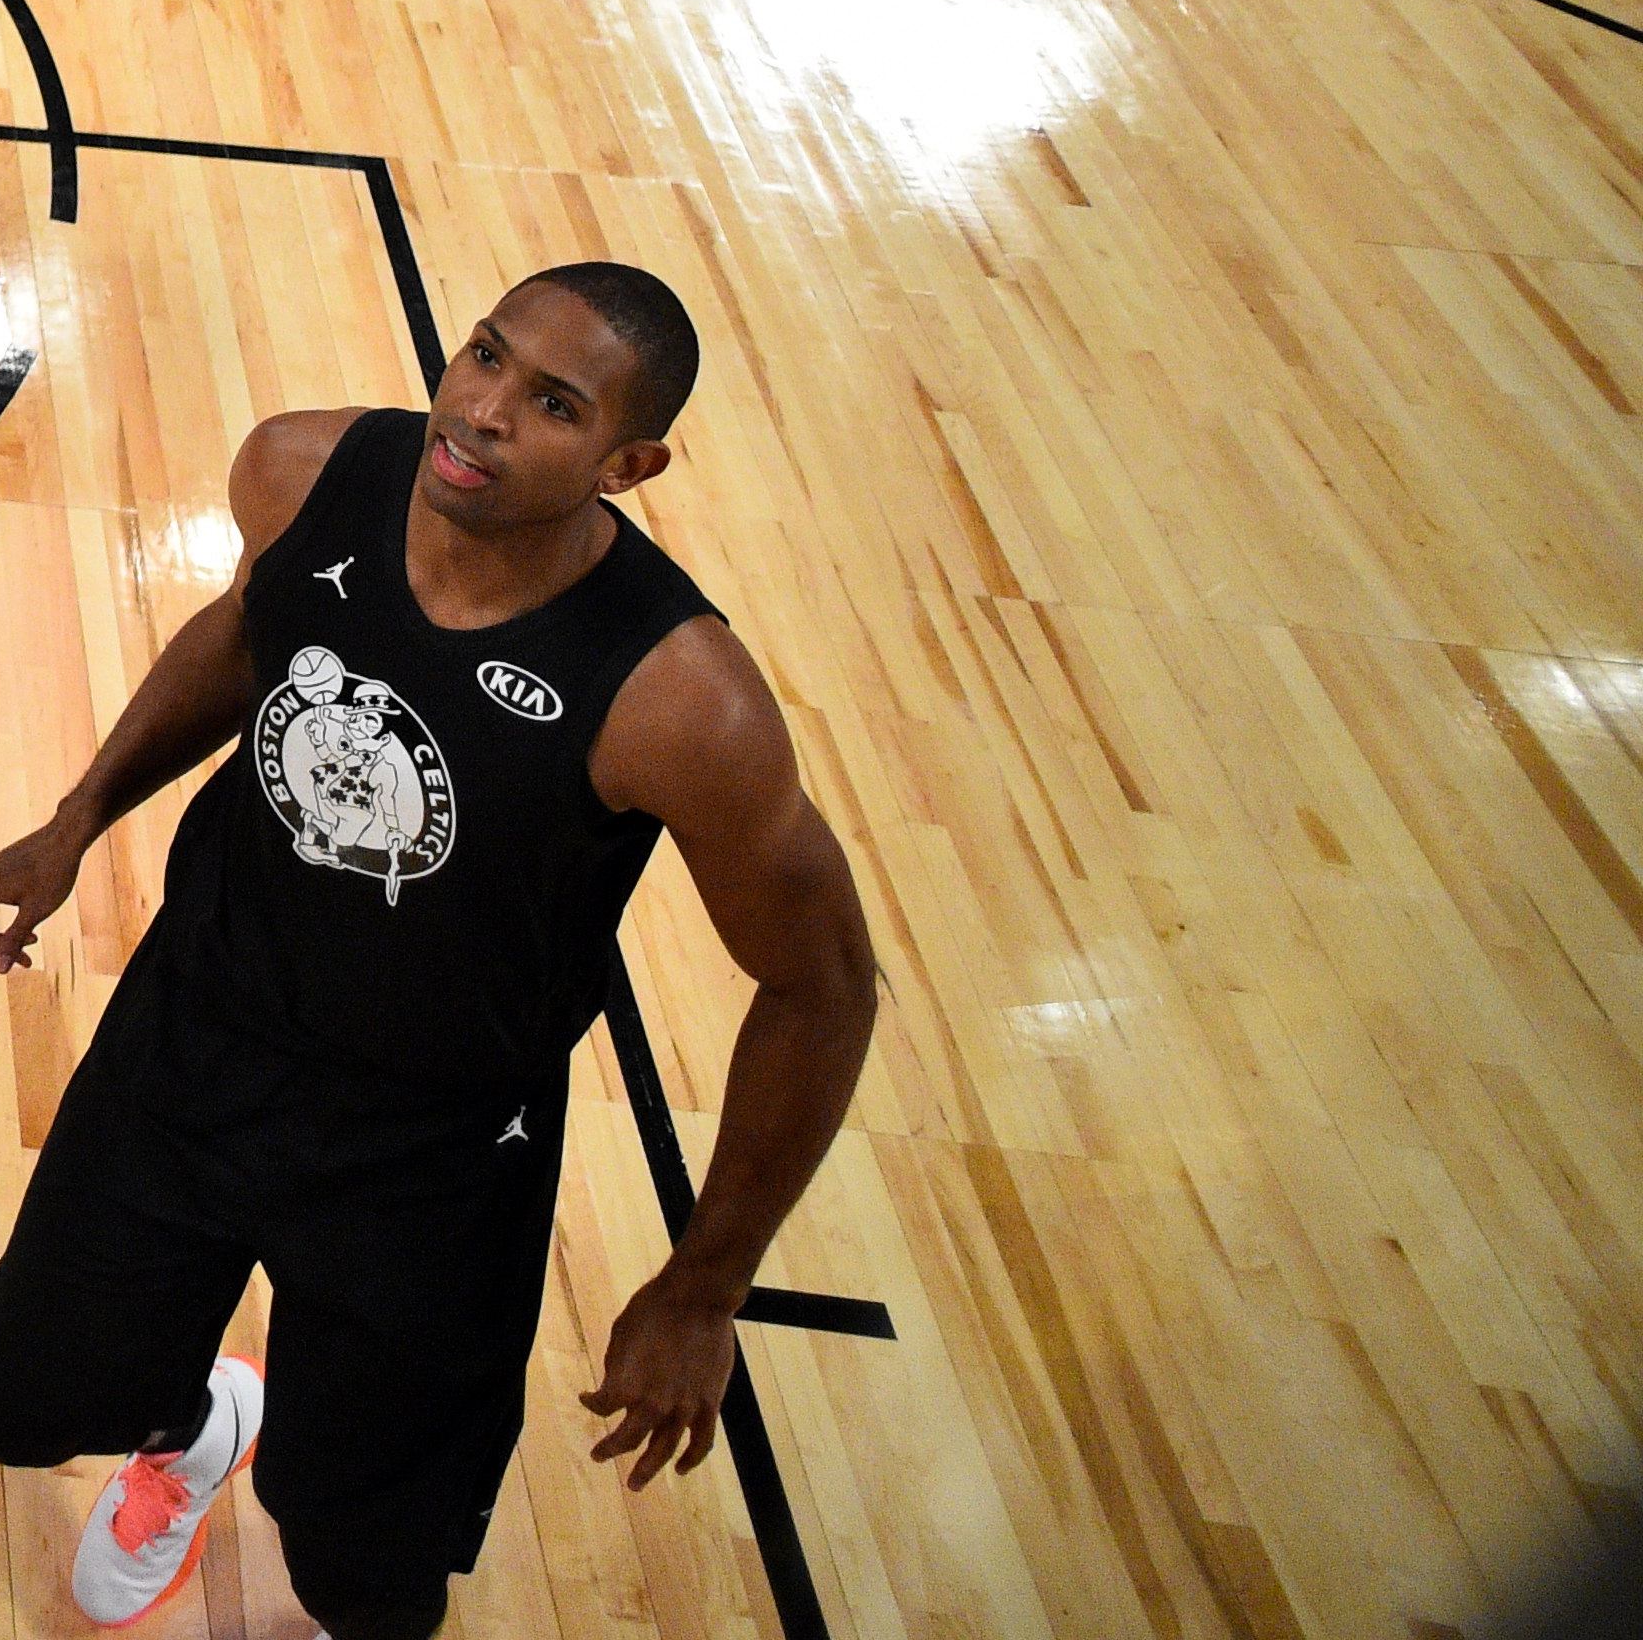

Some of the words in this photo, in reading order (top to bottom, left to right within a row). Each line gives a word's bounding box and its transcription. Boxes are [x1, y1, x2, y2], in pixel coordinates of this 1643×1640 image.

[488, 667, 546, 715] KIA
[263, 690, 302, 804] BOSTON
[414, 744, 450, 863] CELTICS
